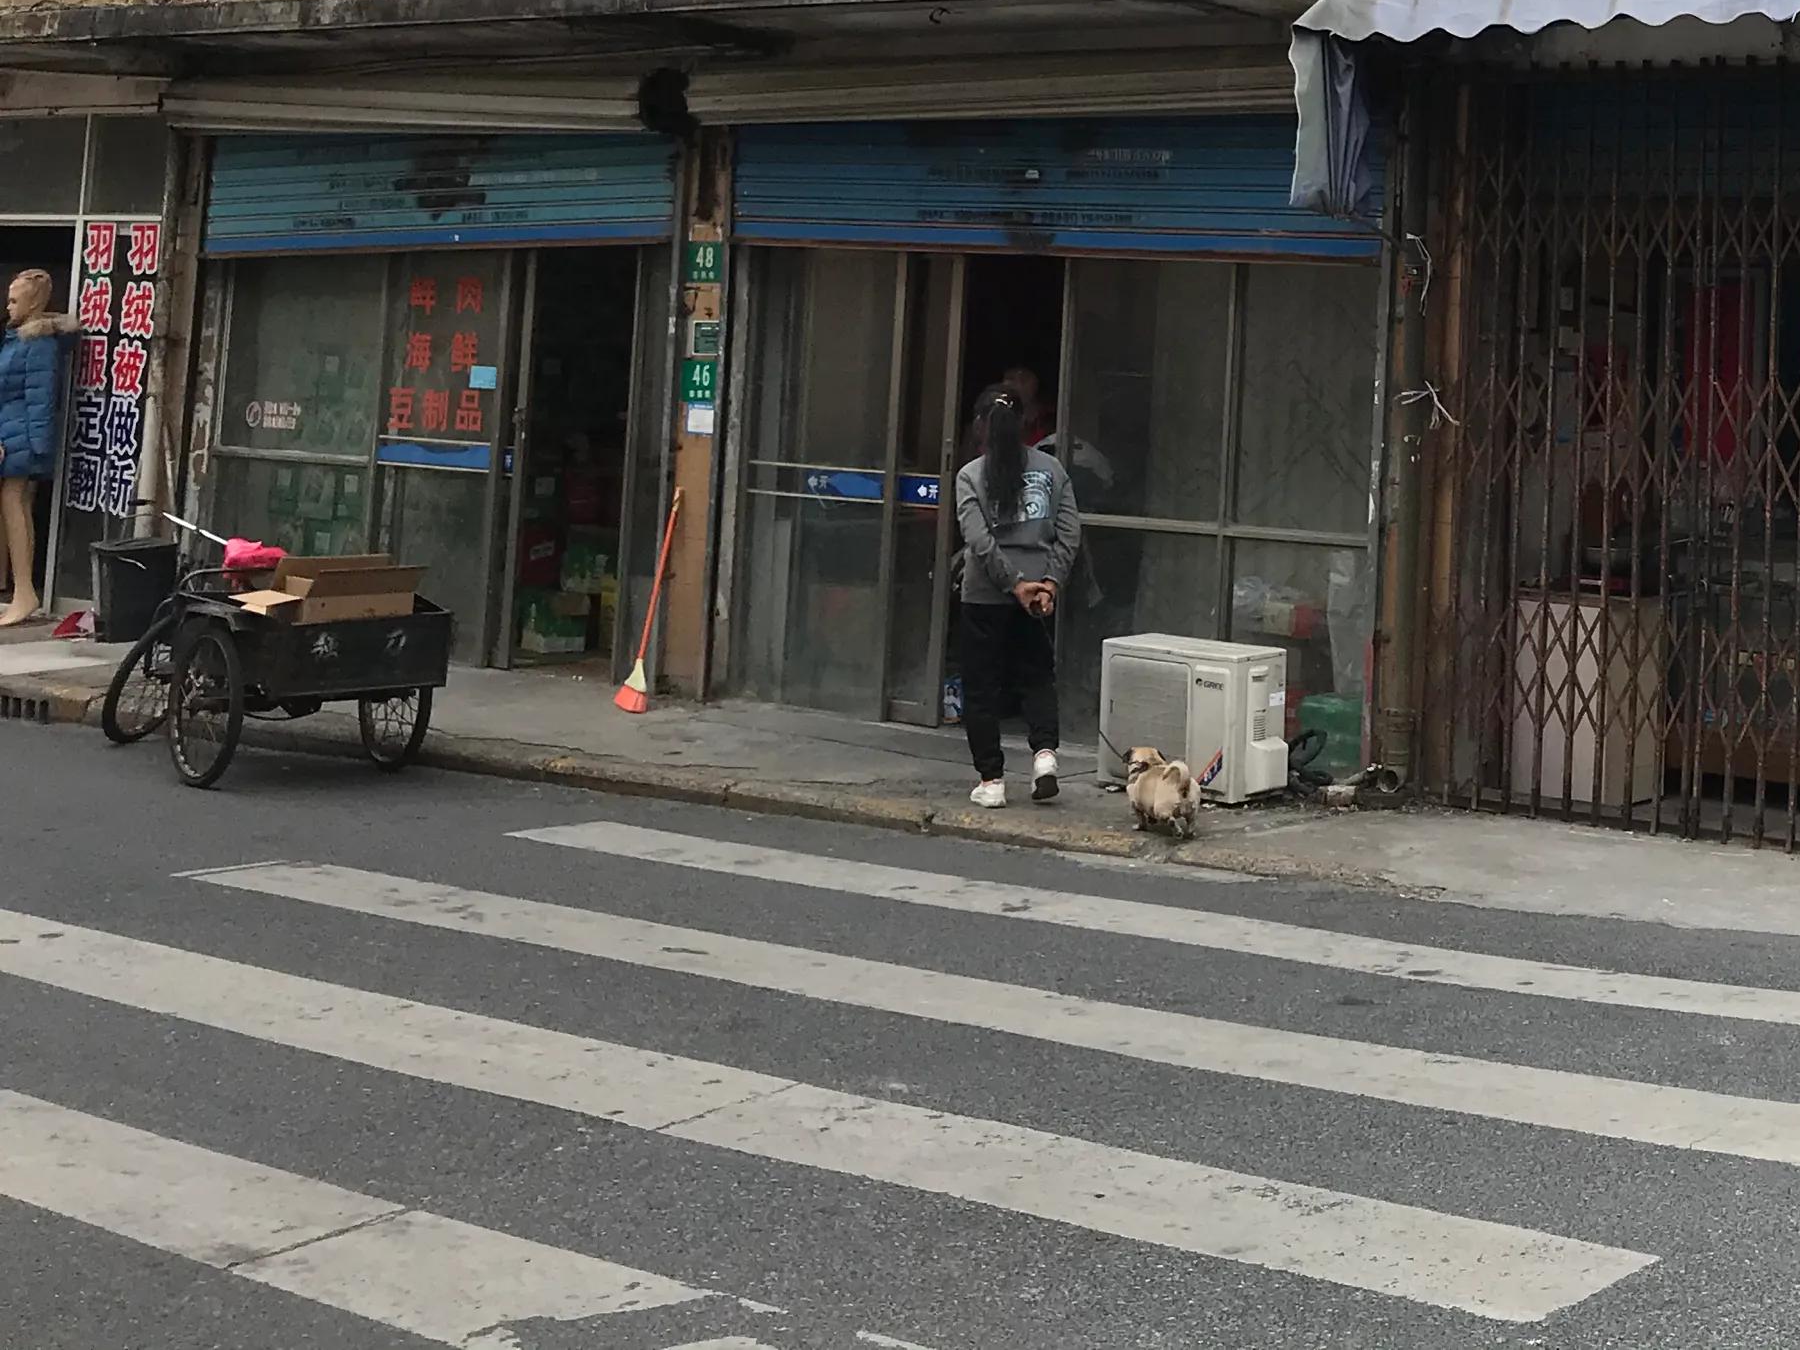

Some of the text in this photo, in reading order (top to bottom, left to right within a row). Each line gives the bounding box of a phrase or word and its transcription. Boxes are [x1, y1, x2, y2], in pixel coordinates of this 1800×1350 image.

[695, 246, 714, 269] 48
[405, 330, 479, 375] 海鲜
[691, 364, 710, 387] 46
[387, 386, 483, 433] 豆制品
